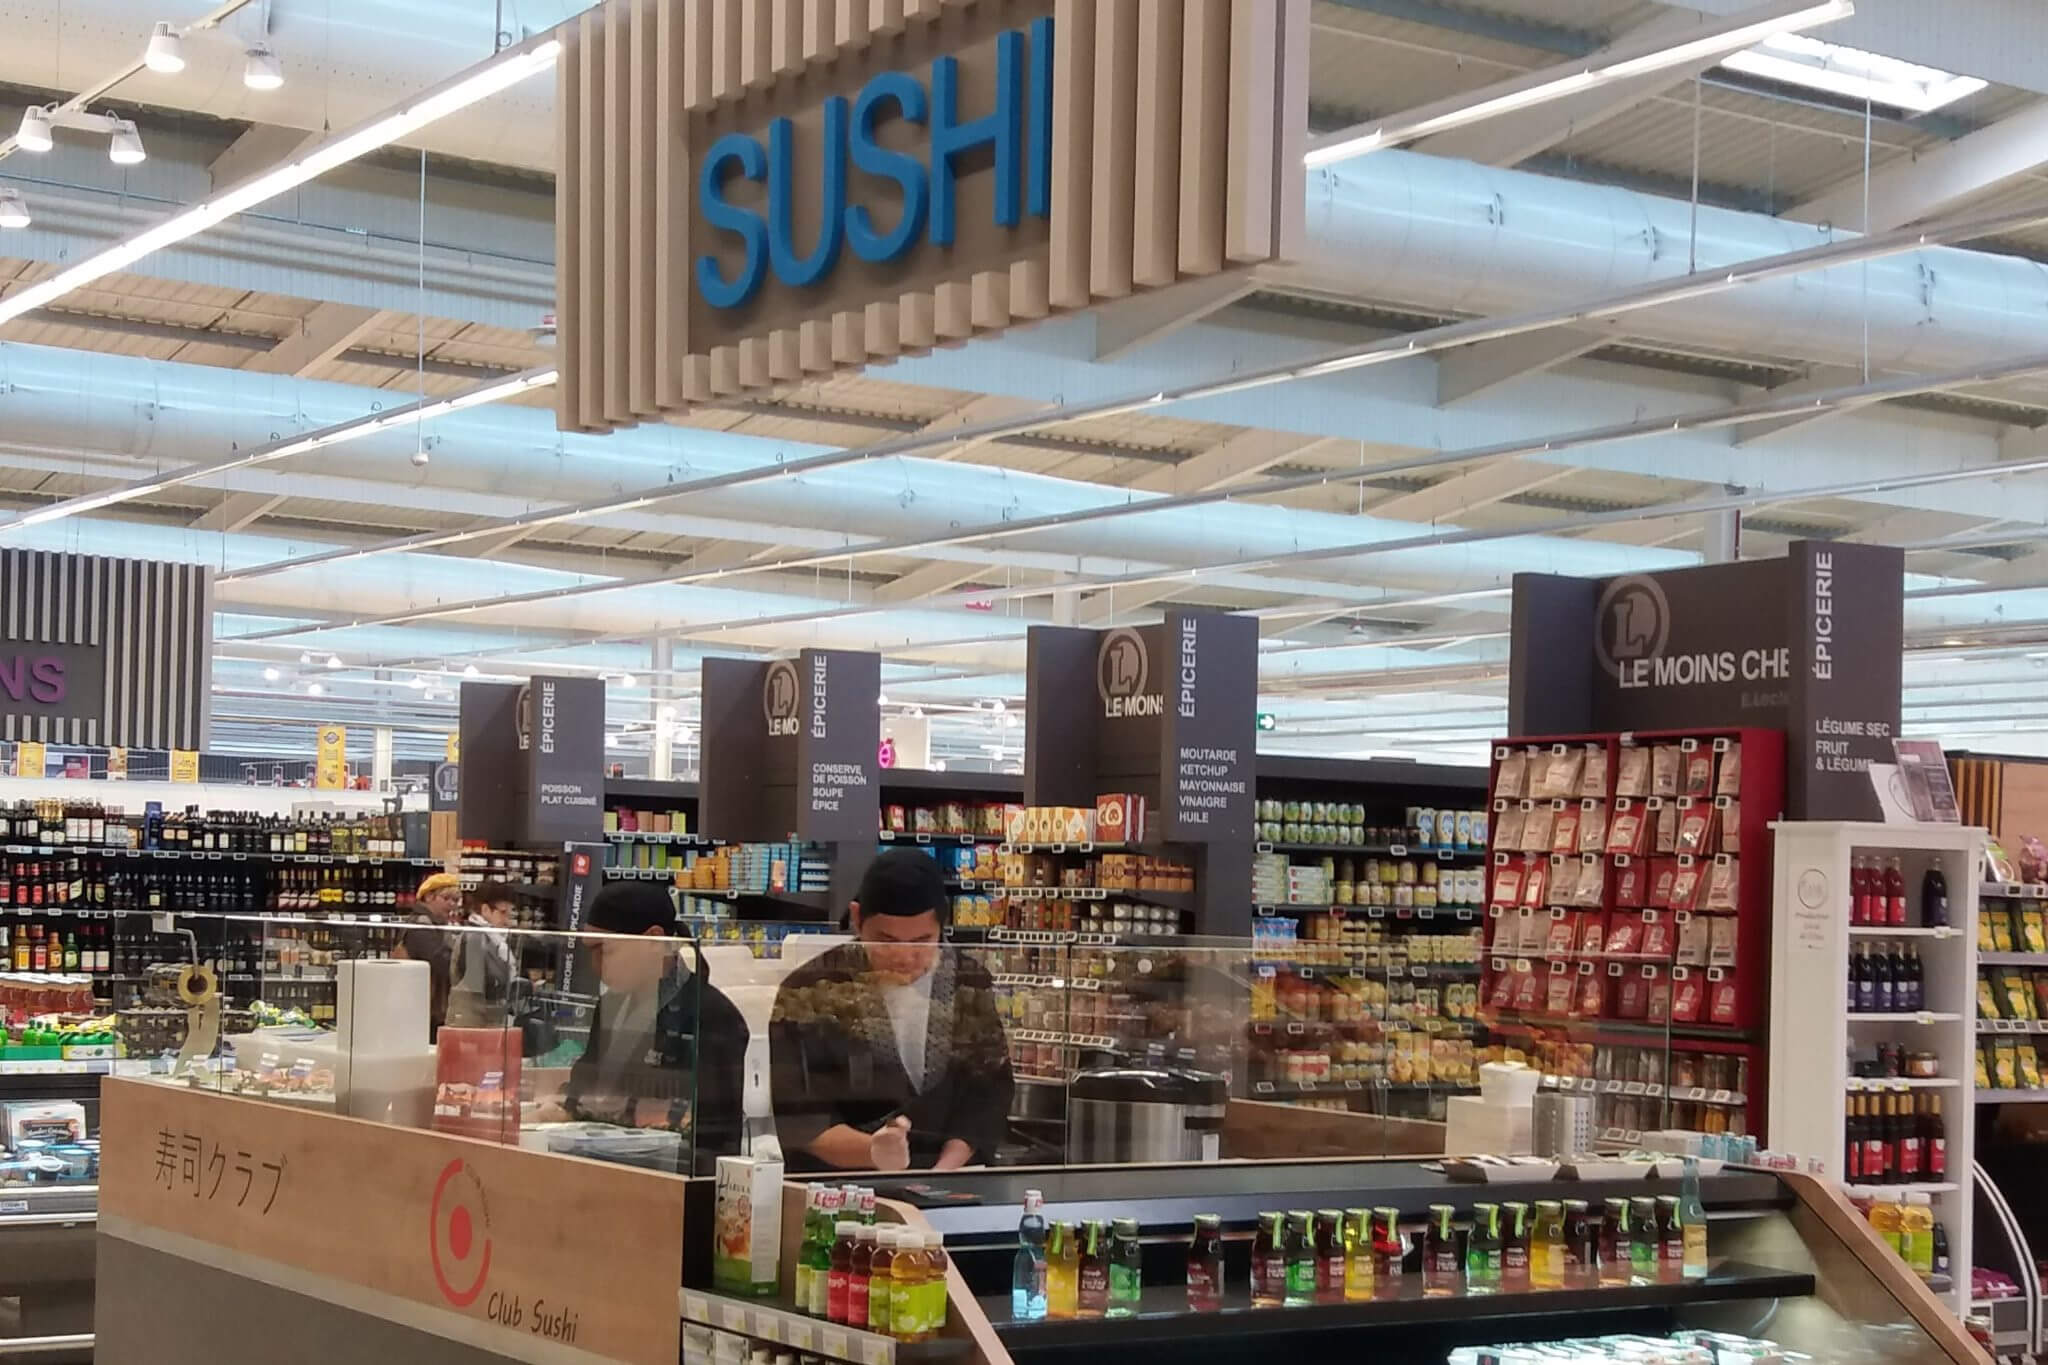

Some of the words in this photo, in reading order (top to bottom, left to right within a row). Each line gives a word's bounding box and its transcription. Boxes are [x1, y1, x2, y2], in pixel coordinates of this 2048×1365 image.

[695, 17, 1055, 309] SUSHI
[1811, 552, 1832, 680] ÉPICERIE
[1178, 618, 1197, 718] ÉPICERIE
[1619, 658, 1649, 689] LE
[1654, 651, 1736, 686] MOINS
[810, 655, 827, 739] ÉPICERIE
[1105, 697, 1122, 718] LE
[539, 681, 555, 754] ÉPICERIE
[769, 718, 781, 736] LE
[782, 717, 799, 736] MO
[1815, 717, 1864, 736] LÉGUME
[1180, 747, 1237, 763] MOUTARDE
[1815, 740, 1849, 755] FRUIT
[812, 763, 862, 775] CONSERVE
[1180, 764, 1229, 777] KETCHUP
[1815, 757, 1825, 771] &
[812, 774, 826, 784] DE
[827, 775, 867, 785] POISSON
[1179, 780, 1246, 793] MAYONNAISE
[541, 783, 582, 794] POISSON
[812, 787, 844, 798] SOUPE
[541, 795, 562, 805] PLAT
[564, 795, 597, 806] CUISINÉ
[812, 798, 839, 810] ÉPICE
[1179, 796, 1228, 809] VINAIGRE
[1179, 811, 1209, 824] HUILE
[155, 1124, 288, 1216] 寿司クラブ
[487, 1290, 522, 1328] Club
[530, 1299, 579, 1343] Sushi
